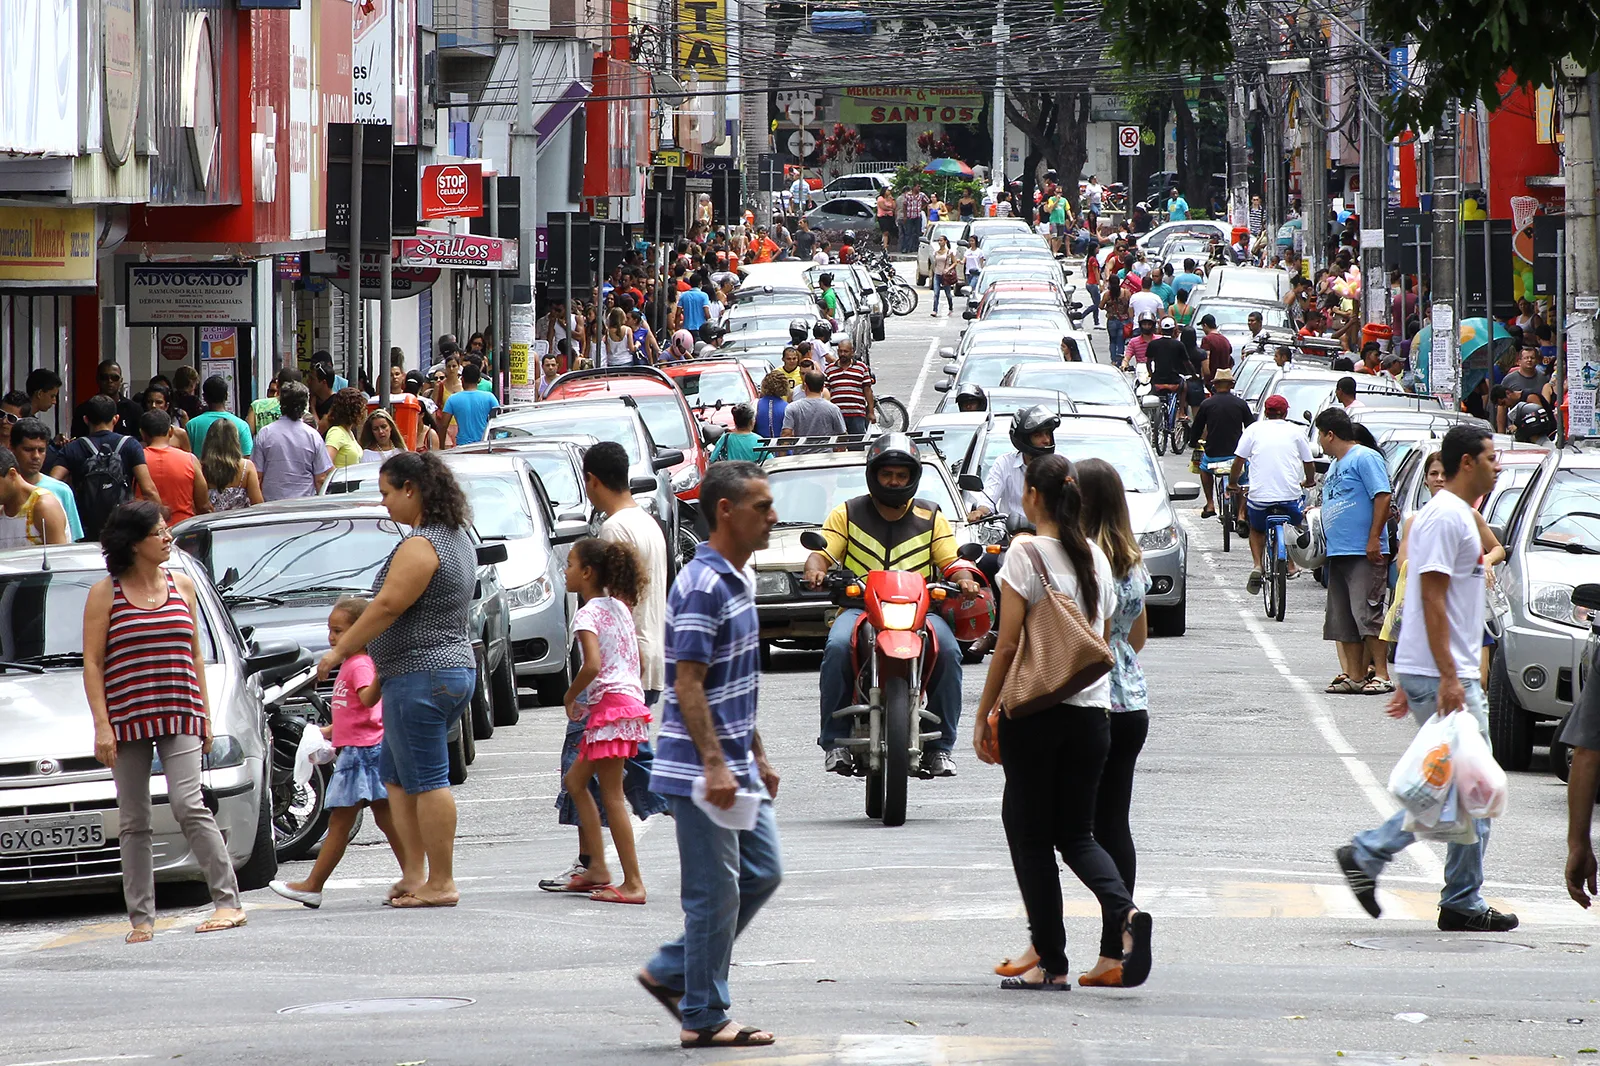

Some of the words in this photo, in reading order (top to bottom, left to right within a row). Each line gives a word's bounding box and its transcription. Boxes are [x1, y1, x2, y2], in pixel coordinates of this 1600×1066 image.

[870, 106, 975, 123] SANTOS
[438, 175, 466, 189] STOP
[439, 188, 465, 196] CELULAR
[416, 237, 489, 259] Stillos
[133, 271, 245, 287] ADVOGADOS
